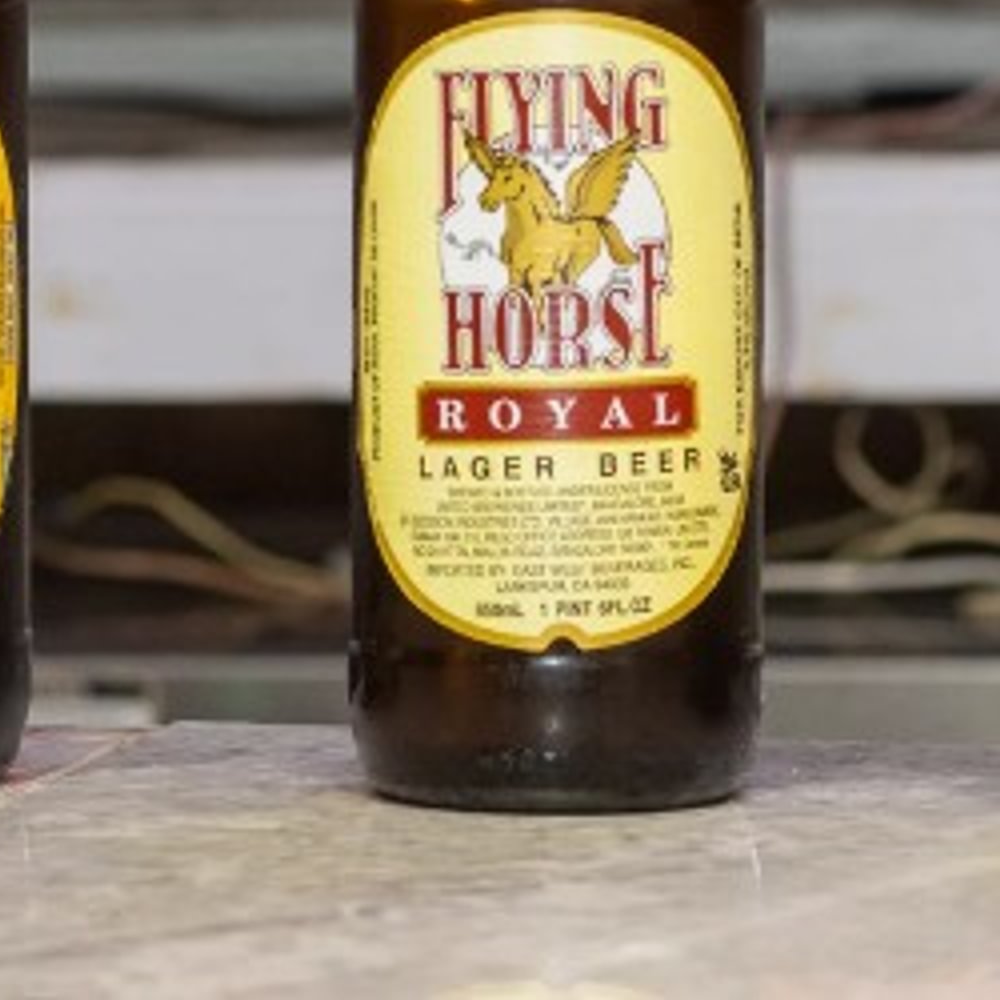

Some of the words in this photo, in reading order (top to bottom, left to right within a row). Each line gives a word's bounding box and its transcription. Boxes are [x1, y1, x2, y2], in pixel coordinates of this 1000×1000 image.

[437, 65, 668, 220] FLYING
[442, 240, 673, 374] HORSE
[437, 391, 681, 432] ROYAL
[419, 455, 555, 480] LAGER
[600, 447, 702, 477] BEER
[555, 599, 593, 617] PINT
